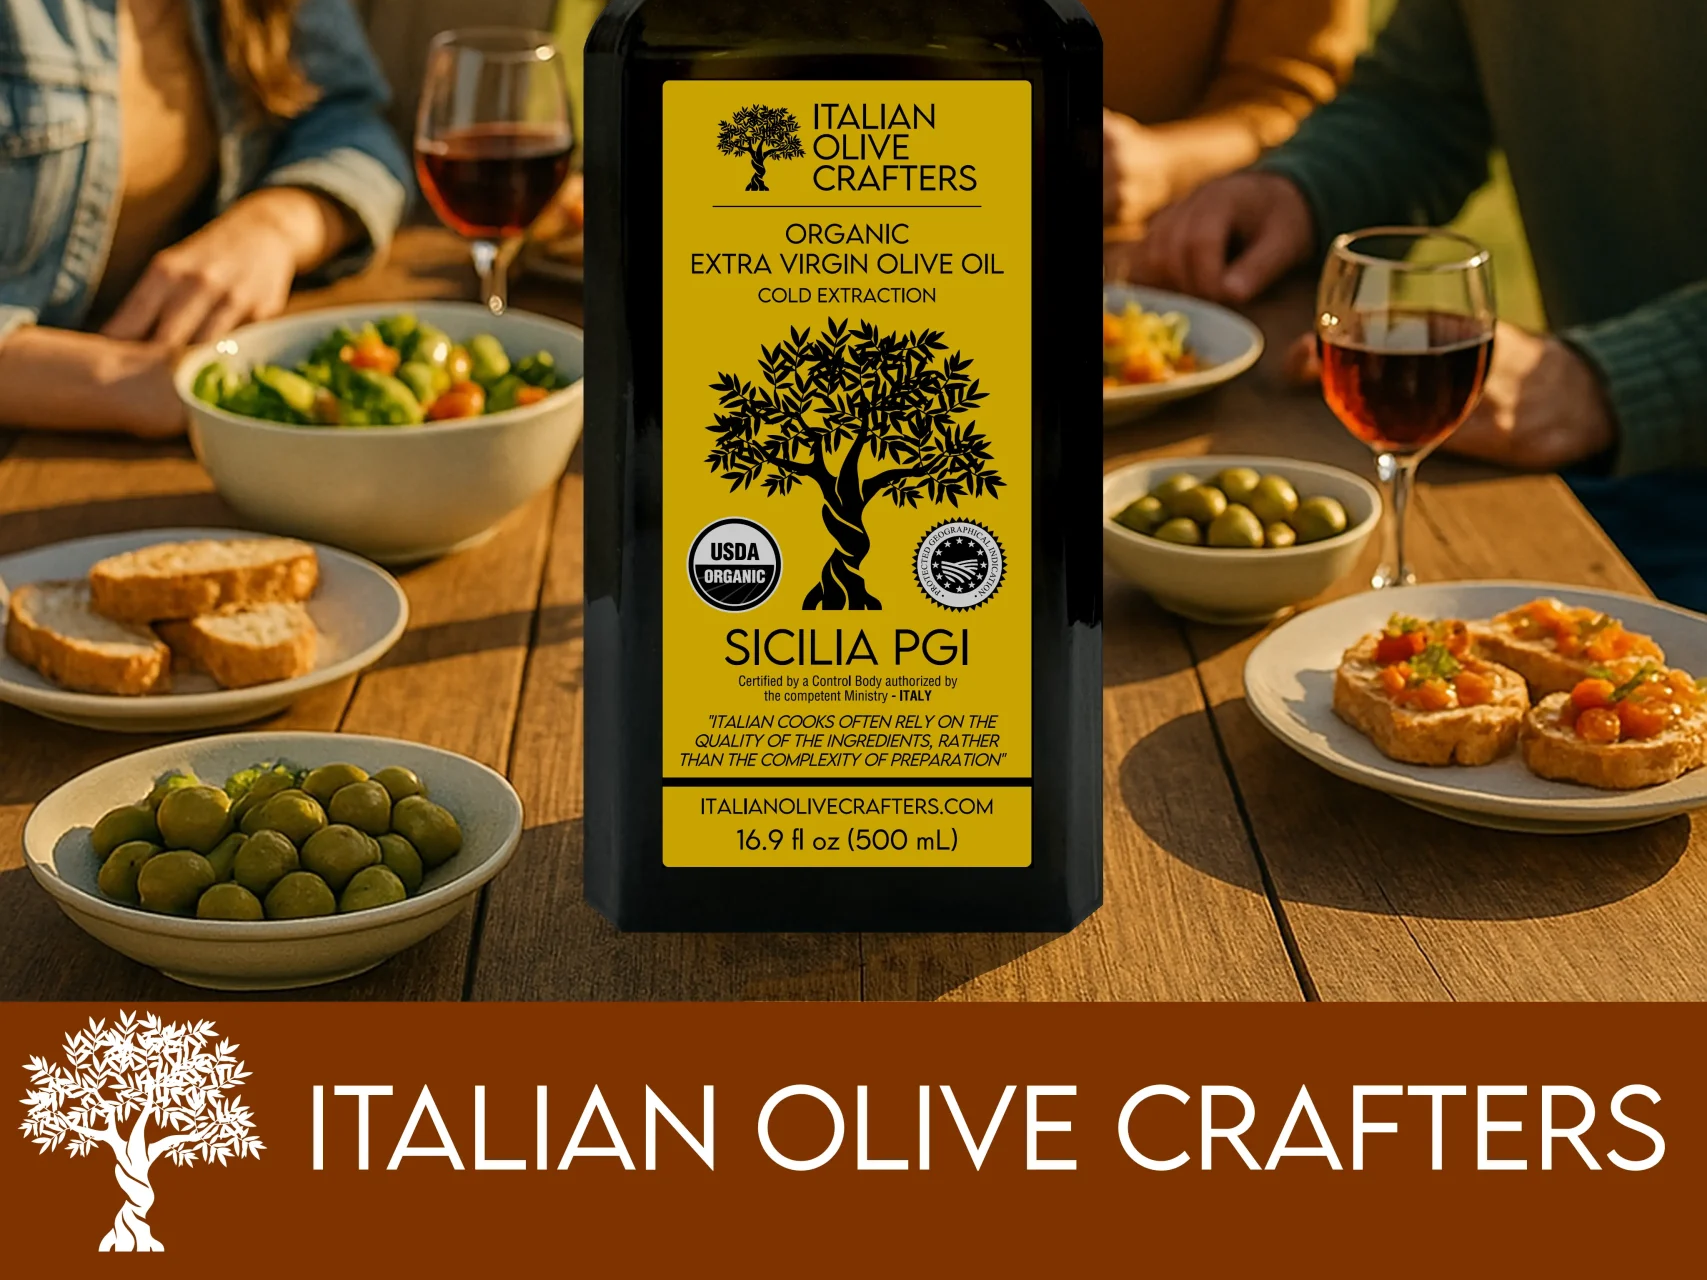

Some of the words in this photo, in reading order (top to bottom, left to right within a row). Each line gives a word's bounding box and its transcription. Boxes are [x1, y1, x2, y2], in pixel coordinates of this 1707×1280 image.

[815, 104, 934, 129] ITALIAN
[813, 134, 909, 160] OLIVE
[813, 165, 977, 191] CRAFTERS
[786, 223, 909, 244] ORGANIC
[692, 254, 771, 274] EXTRA
[780, 253, 867, 274] VIRGIN
[877, 253, 952, 274] OLIVE
[962, 253, 1004, 274] OIL
[758, 288, 811, 303] COLD
[818, 288, 935, 303] EXTRACTION
[929, 526, 991, 547] GEOGRAPHICAL
[711, 542, 759, 560] USDA
[704, 569, 765, 583] ORGANIC
[921, 546, 941, 596] PROTECTED
[978, 547, 998, 597] INDICATION
[725, 629, 878, 665] SICILIA
[896, 629, 967, 665] PGI
[739, 675, 782, 686] Certified
[787, 676, 799, 688] by
[803, 678, 808, 686] a
[813, 675, 851, 686] Control
[856, 675, 882, 689] Body
[886, 676, 940, 686] authorized
[945, 676, 957, 688] by
[764, 690, 780, 701] the
[785, 691, 841, 703] competent
[845, 690, 888, 703] Ministry
[900, 690, 931, 701] ITALY
[709, 715, 774, 728] "ITALIAN
[778, 715, 835, 728] COOKS
[839, 715, 892, 728] OFTEN
[895, 715, 935, 728] RELY
[938, 715, 964, 728] ON
[970, 715, 998, 728] THE
[696, 734, 764, 747] QUALITY
[768, 734, 791, 747] OF
[796, 734, 824, 747] THE
[827, 734, 932, 750] INGREDIENTS,
[939, 734, 1000, 747] RATHER
[681, 753, 724, 766] THAN
[729, 753, 758, 766] THE
[761, 753, 862, 766] COMPLEXITY
[865, 753, 888, 766] OF
[891, 753, 1007, 766] PREPARATION"
[702, 798, 992, 814] ITALIANOLIVECRAFTERS.COM
[737, 829, 783, 850] 16.9
[792, 828, 803, 850] fl
[813, 837, 839, 850] oz
[848, 828, 907, 851] (500
[917, 828, 957, 851] mL)
